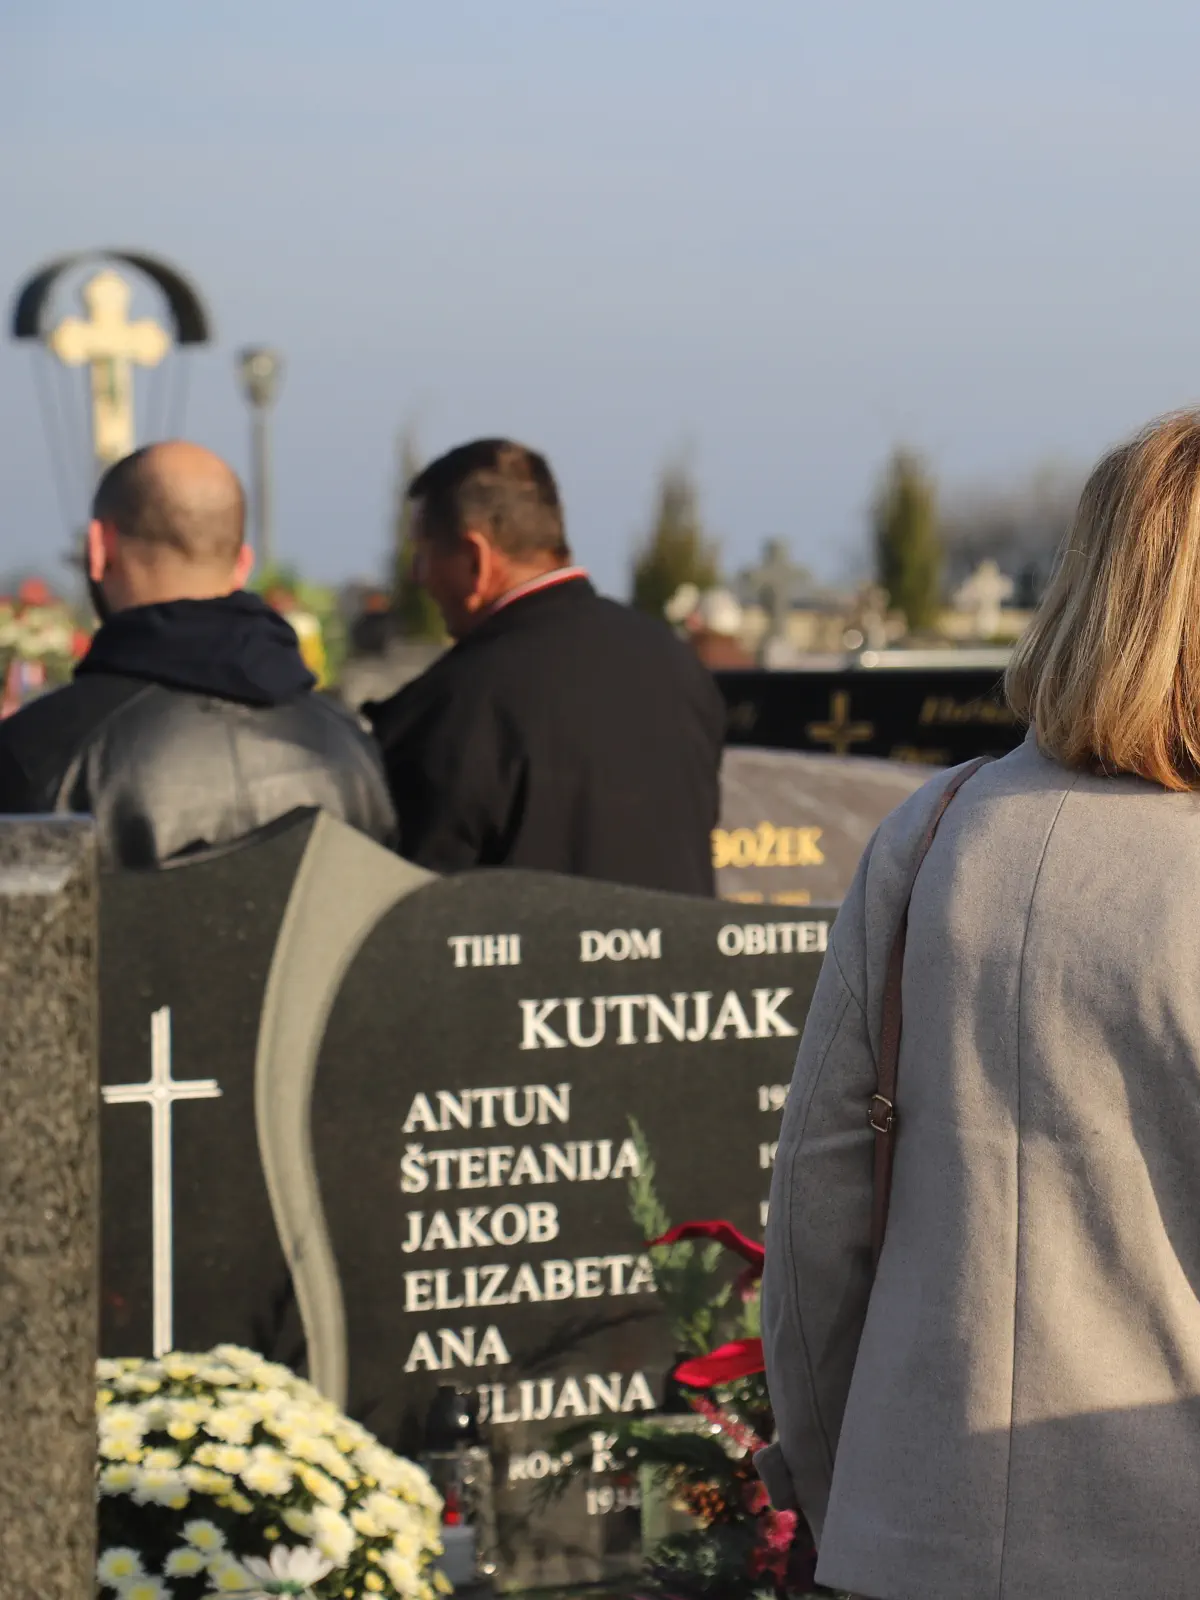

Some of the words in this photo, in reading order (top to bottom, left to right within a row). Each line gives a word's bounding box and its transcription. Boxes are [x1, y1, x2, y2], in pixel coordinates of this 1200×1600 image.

[448, 933, 521, 968] TIHI
[579, 927, 662, 962] DOM
[717, 920, 829, 957] OBITEL
[518, 987, 798, 1050] KUTNJAK
[402, 1083, 571, 1134] ANTUN
[400, 1138, 641, 1194] ŠTEFANIJA
[401, 1201, 560, 1254] JAKOB
[403, 1253, 658, 1313] ELIZABETA
[403, 1325, 511, 1373] ANA
